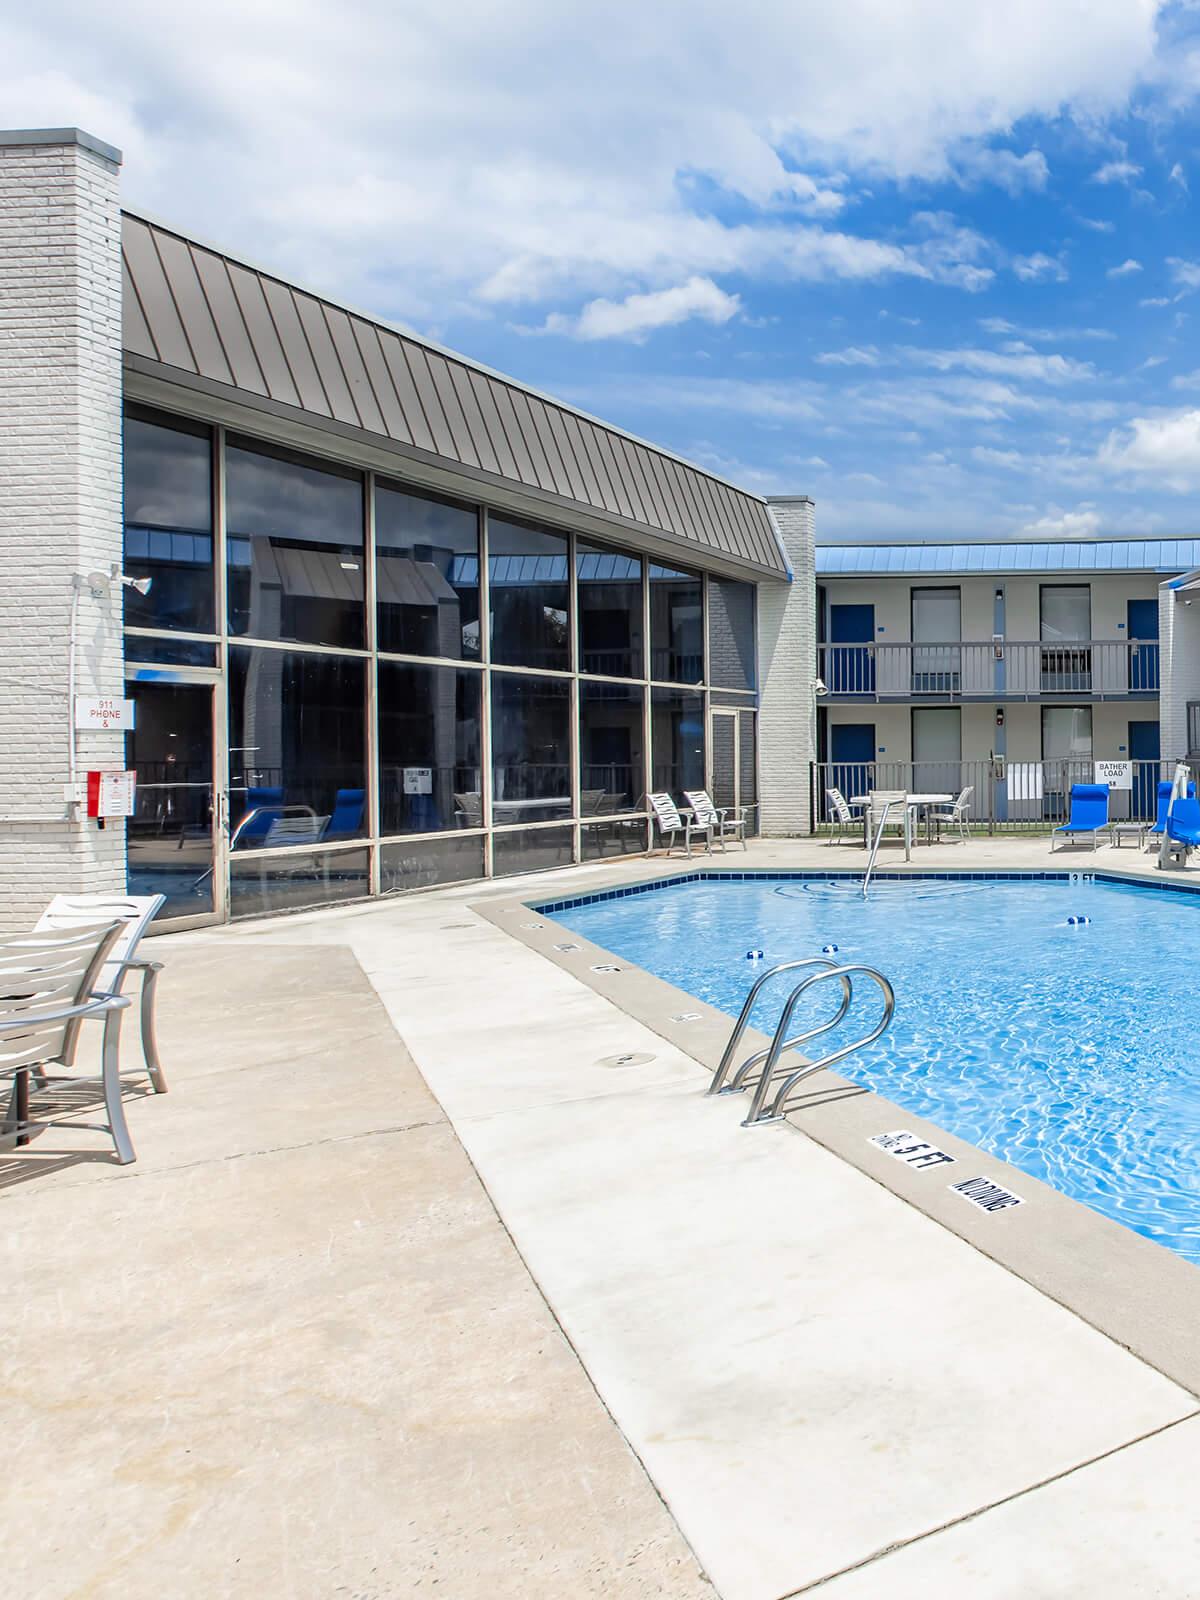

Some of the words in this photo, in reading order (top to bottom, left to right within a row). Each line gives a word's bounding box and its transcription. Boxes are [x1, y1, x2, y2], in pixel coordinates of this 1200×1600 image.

[99, 701, 113, 709] 911
[91, 710, 120, 719] PHONE
[103, 720, 109, 728] &
[893, 1143, 931, 1155] 5
[906, 1151, 956, 1169] FT
